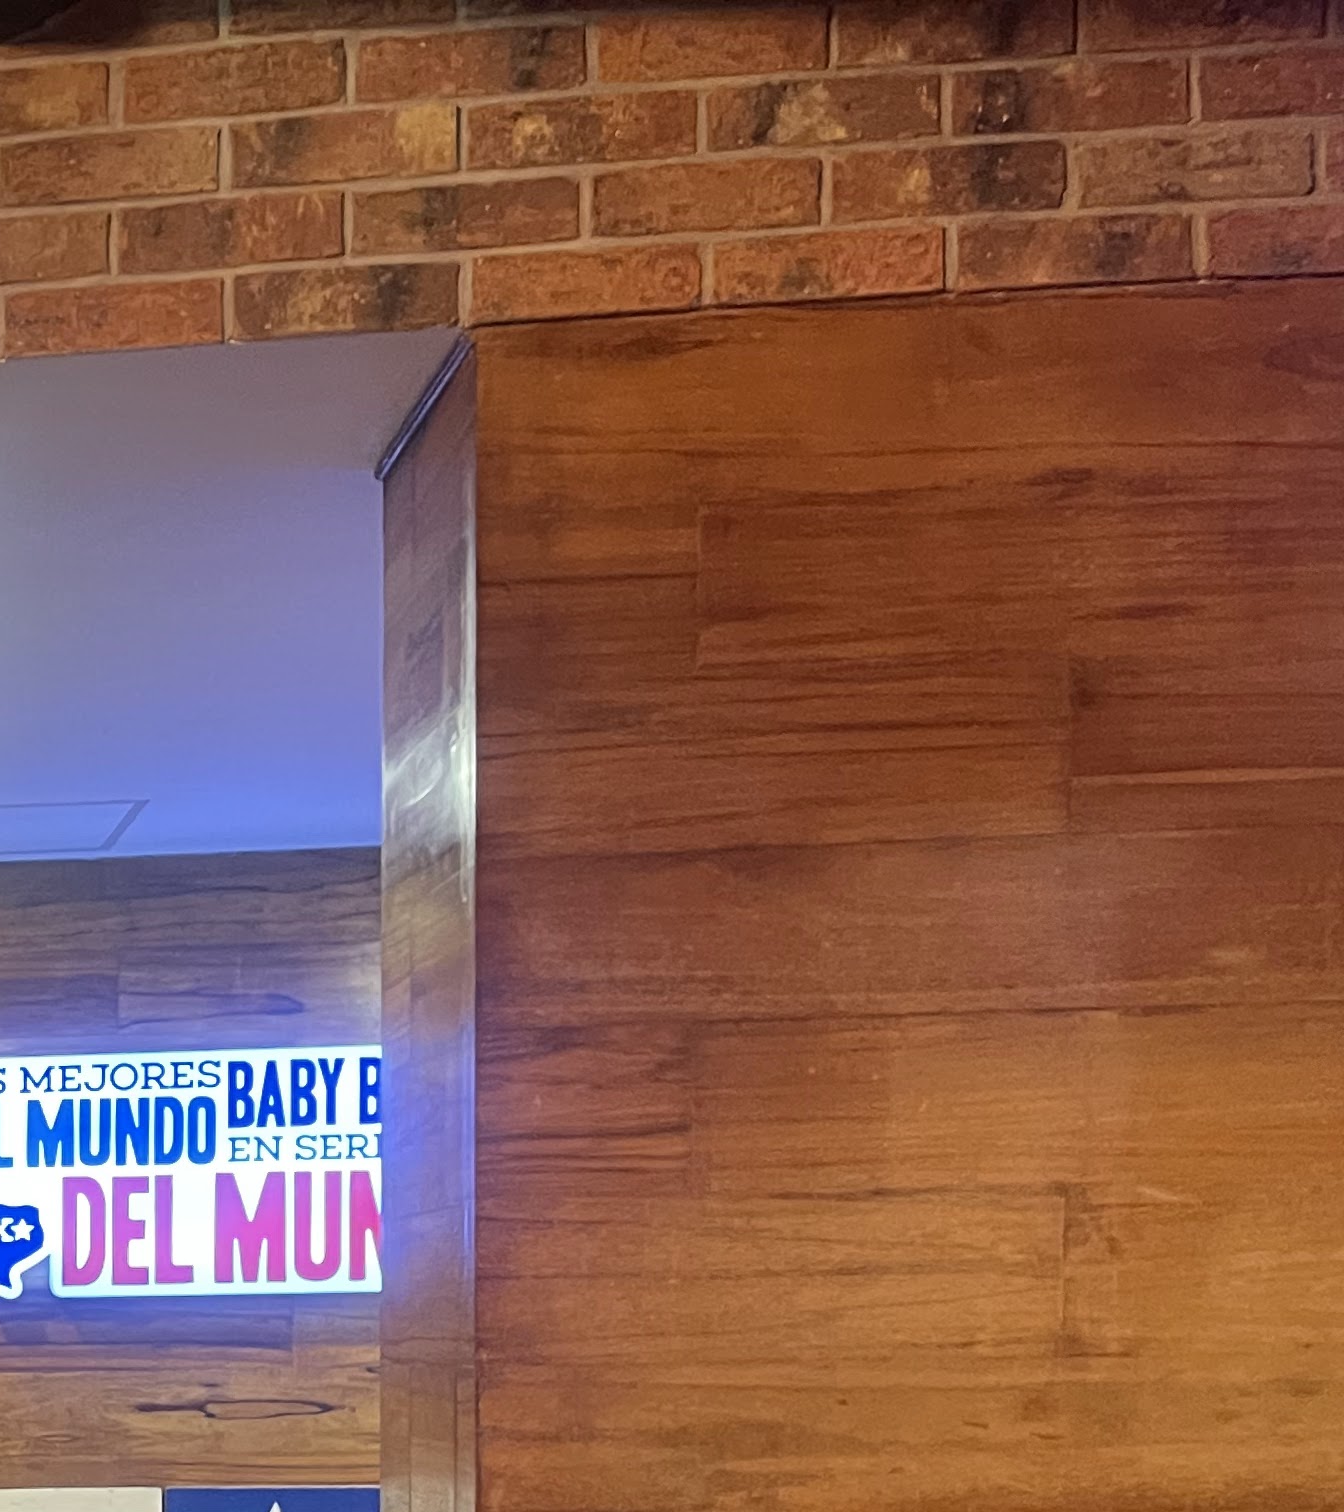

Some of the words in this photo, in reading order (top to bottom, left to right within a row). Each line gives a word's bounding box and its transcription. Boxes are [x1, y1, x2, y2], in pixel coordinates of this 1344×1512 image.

[19, 1060, 221, 1094] MEJORES
[227, 1057, 346, 1129] BABY
[26, 1095, 217, 1168] MUNDO
[228, 1135, 284, 1162] EN
[61, 1174, 194, 1286] DEL
[214, 1170, 382, 1283] MUN
